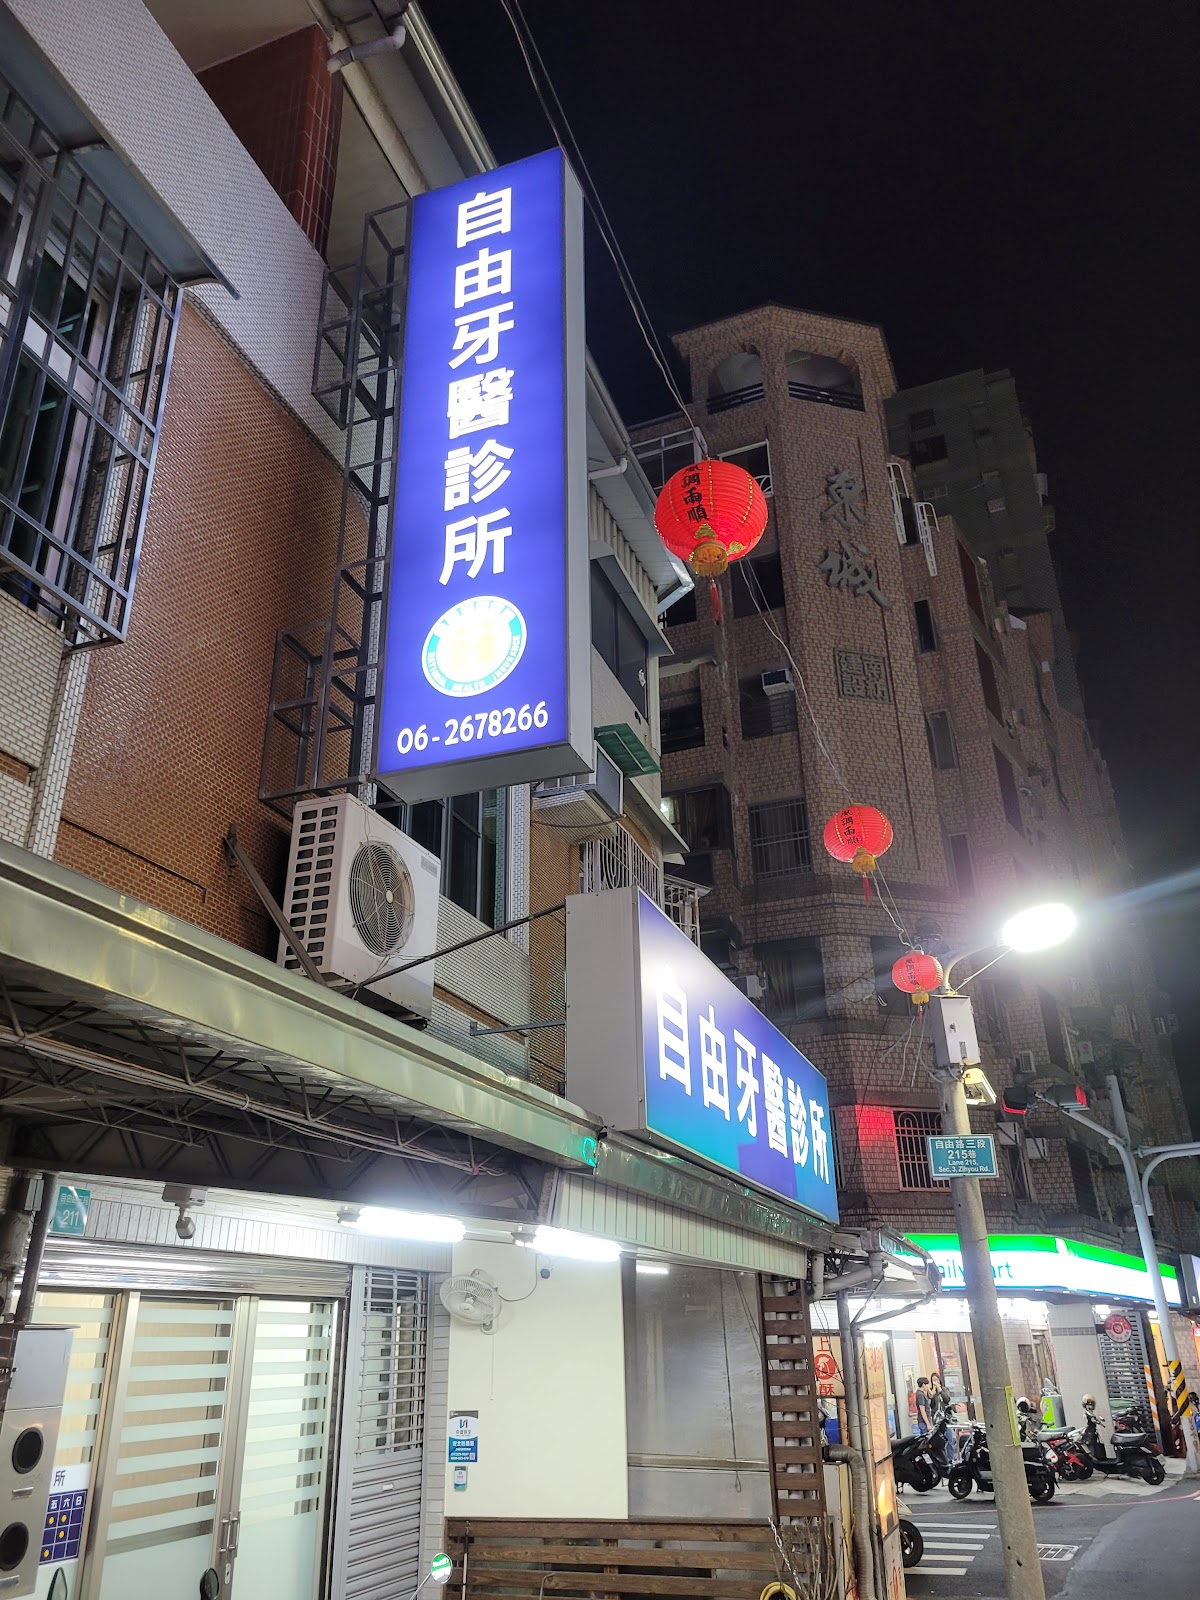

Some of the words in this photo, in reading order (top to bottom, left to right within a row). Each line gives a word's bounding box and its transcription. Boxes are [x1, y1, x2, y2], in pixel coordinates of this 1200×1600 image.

[439, 185, 515, 586] 自由牙醫診所
[656, 966, 830, 1184] 自由牙醫診所
[935, 1140, 986, 1149] 自由路三段
[948, 1150, 977, 1159] 215巷
[62, 1209, 80, 1226] 211
[817, 1337, 830, 1351] 上
[53, 1470, 66, 1487] 所
[50, 1499, 58, 1509] 五
[63, 1498, 70, 1507] 六
[75, 1496, 82, 1506] 日
